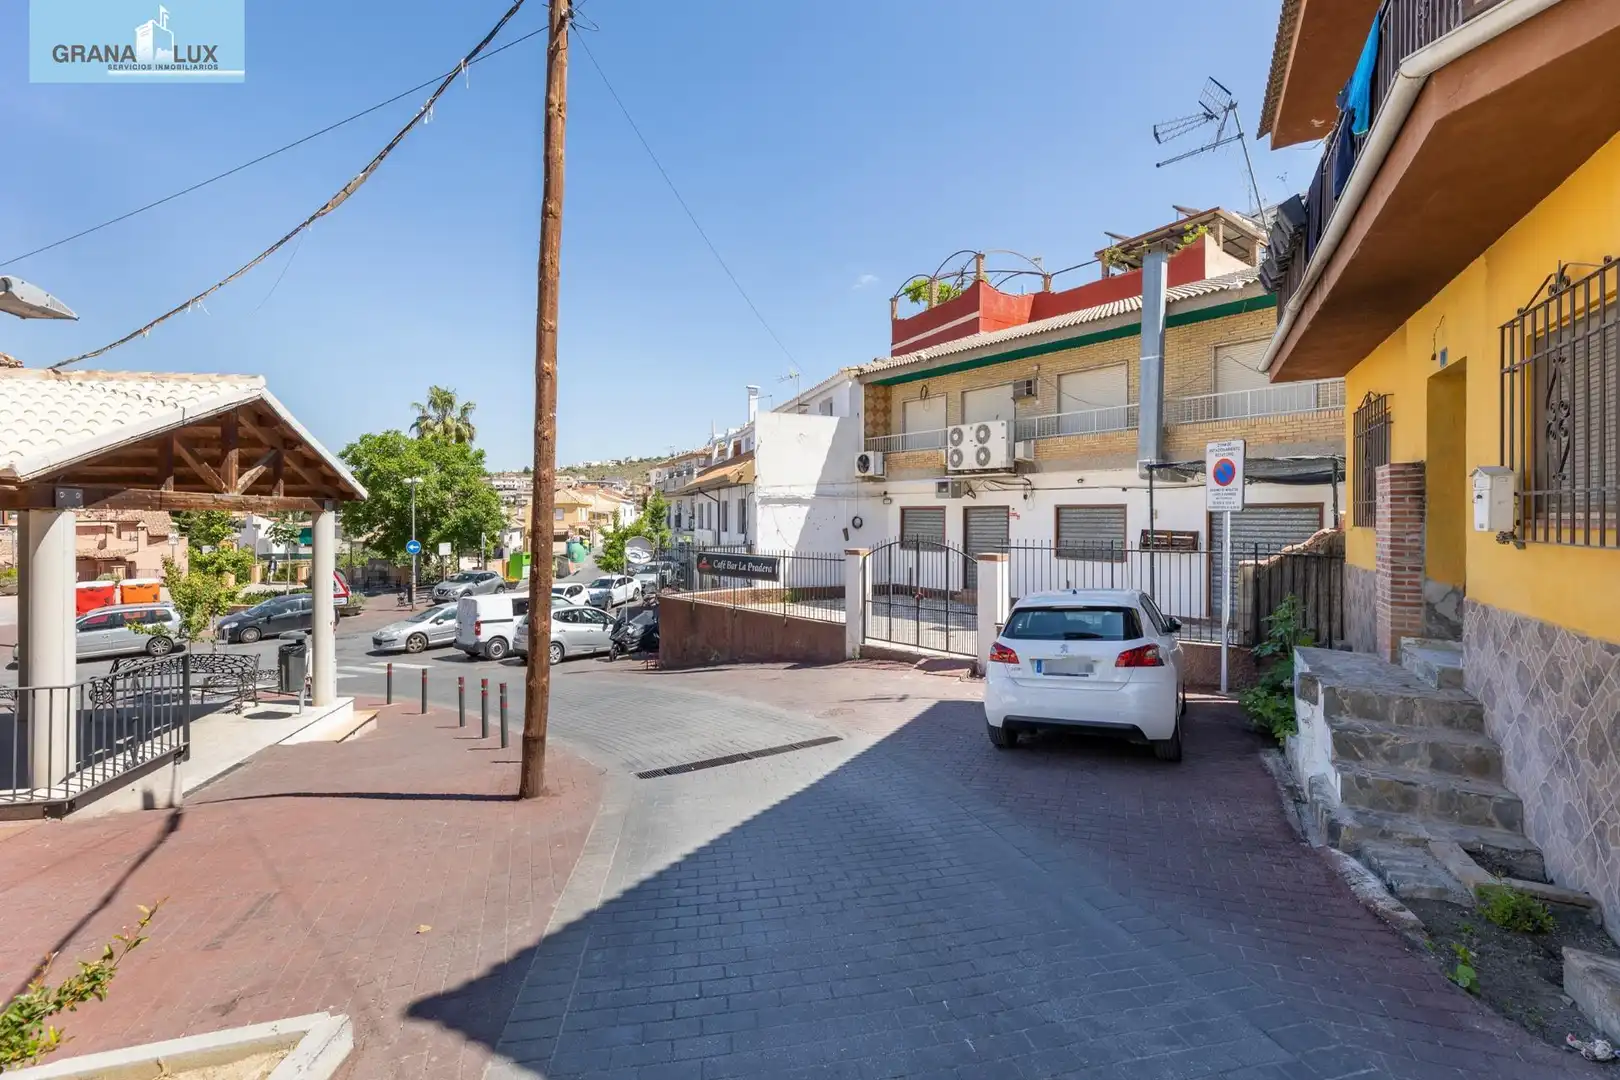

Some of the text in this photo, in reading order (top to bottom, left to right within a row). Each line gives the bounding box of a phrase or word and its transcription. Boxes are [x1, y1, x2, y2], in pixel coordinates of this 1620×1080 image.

[713, 559, 773, 573] Café Bar La Pradera
